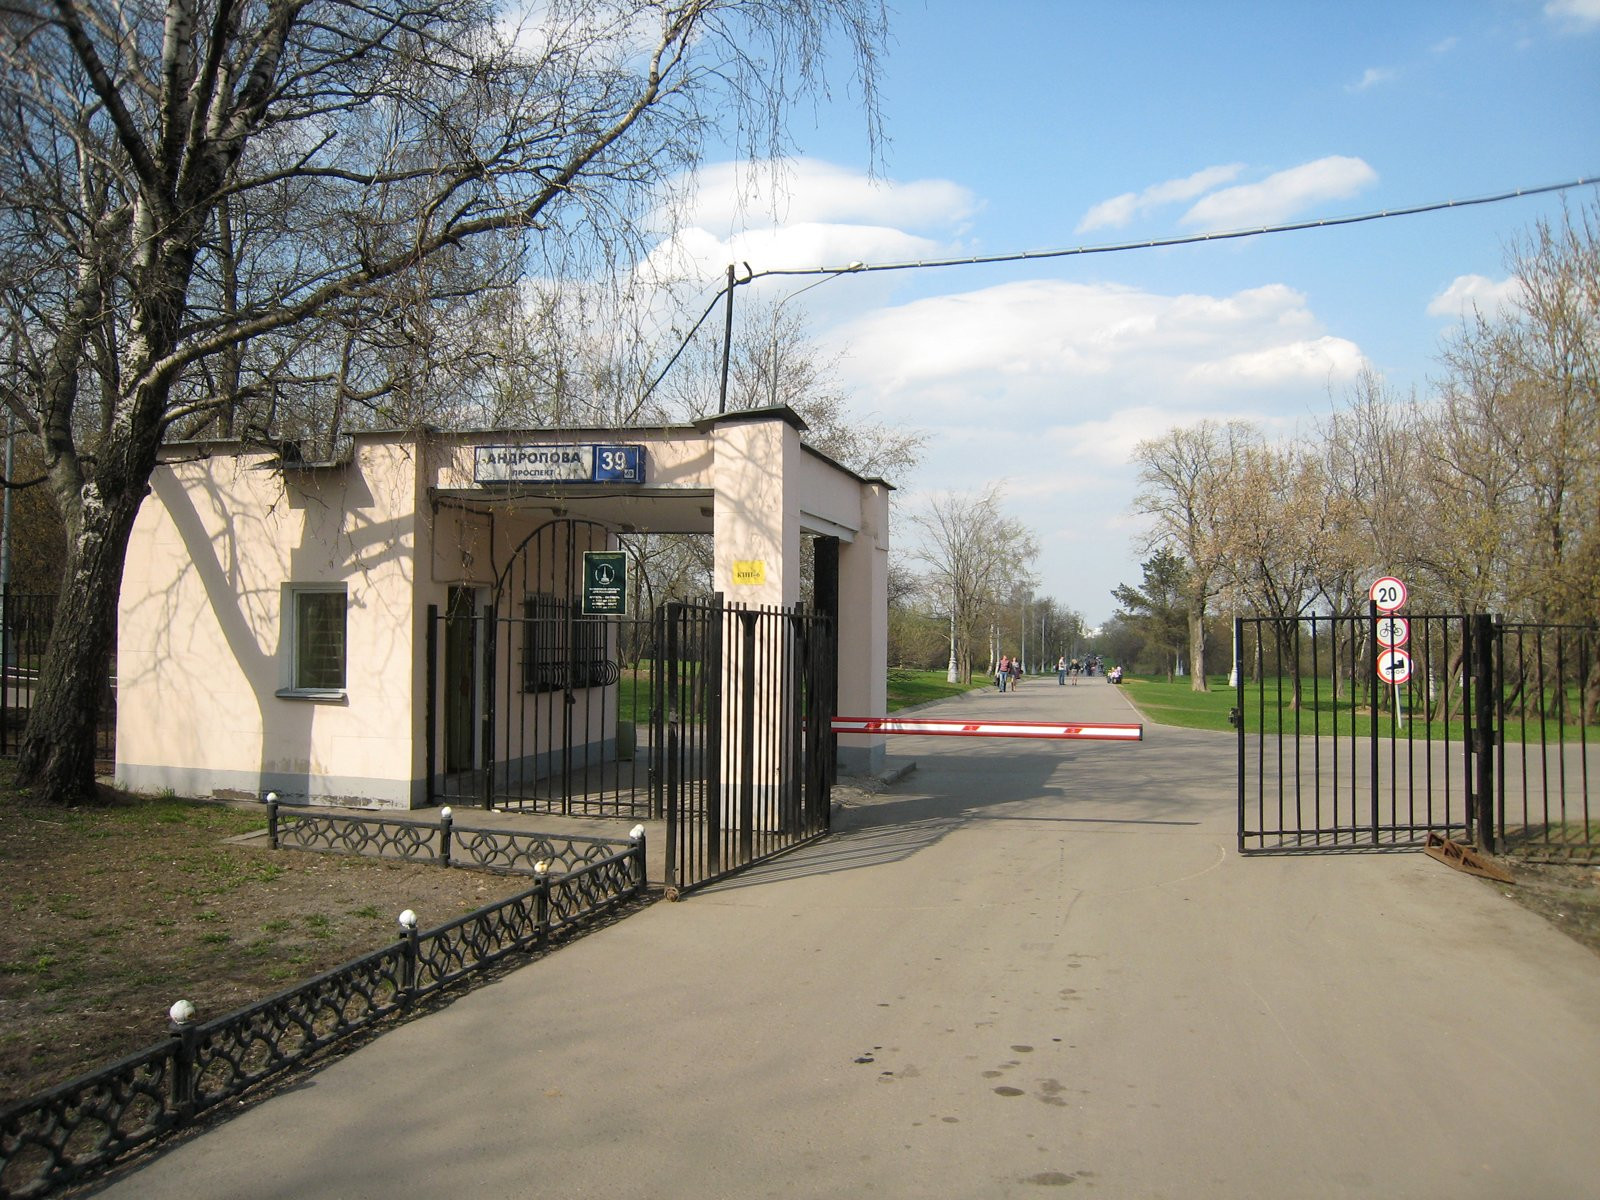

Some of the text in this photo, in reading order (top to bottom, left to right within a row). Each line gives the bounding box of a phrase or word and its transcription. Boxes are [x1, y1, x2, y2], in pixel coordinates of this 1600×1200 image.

[487, 452, 581, 465] АНДРОПОВА
[602, 451, 625, 470] 39
[513, 469, 555, 477] ПРОСПЕКТ
[1379, 587, 1397, 602] 20
